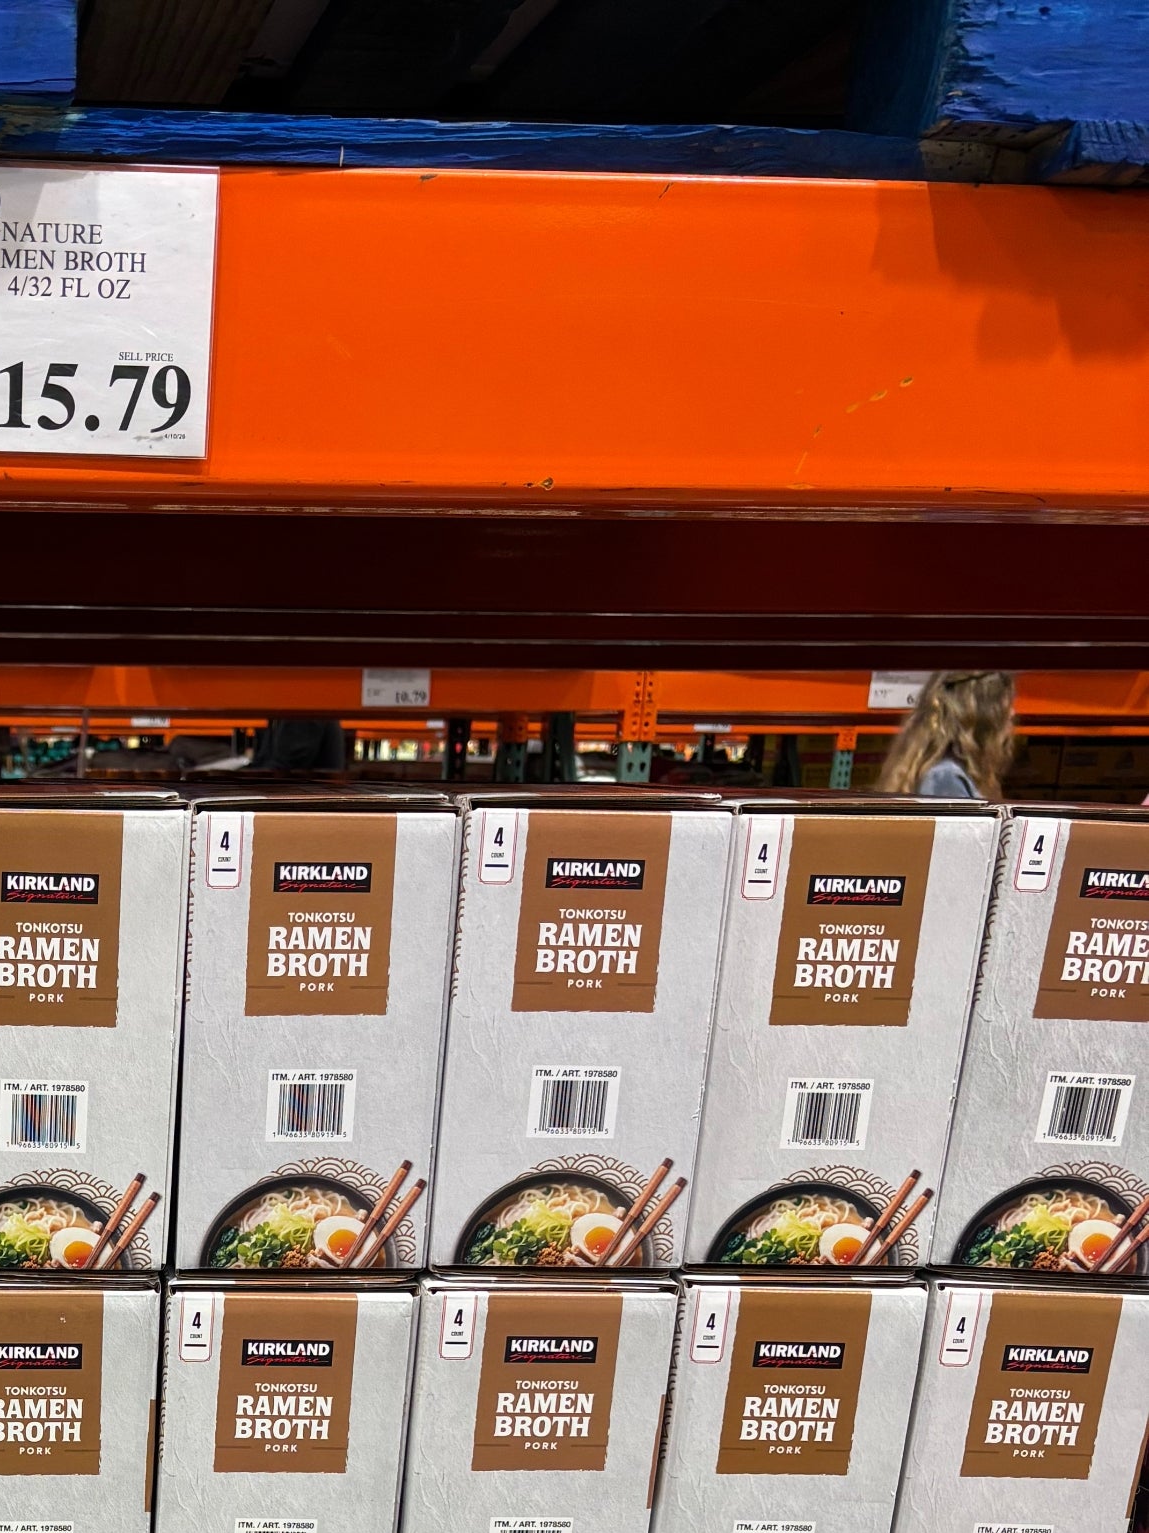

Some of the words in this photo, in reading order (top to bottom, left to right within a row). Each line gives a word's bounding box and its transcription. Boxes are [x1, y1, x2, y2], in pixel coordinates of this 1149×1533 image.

[64, 251, 146, 272] BROTH
[8, 276, 51, 296] 4/32
[61, 278, 89, 297] FL
[98, 279, 130, 299] OZ
[119, 352, 142, 361] SELL
[145, 353, 173, 362] PRICE
[0, 362, 191, 433] 15.79
[7, 876, 95, 891] KIRKLAND
[1088, 872, 1149, 888] KIRKLA
[16, 923, 82, 933] TONKOTSU
[1091, 918, 1149, 930] TONKOTS
[1066, 931, 1149, 957] RAME
[30, 994, 63, 1002] PORK
[1091, 988, 1126, 998] PORK
[1050, 1075, 1068, 1084] ITM.
[1076, 1077, 1094, 1085] ART.
[1098, 1078, 1131, 1086] 1978580
[5, 1387, 66, 1395] TONKOTSU
